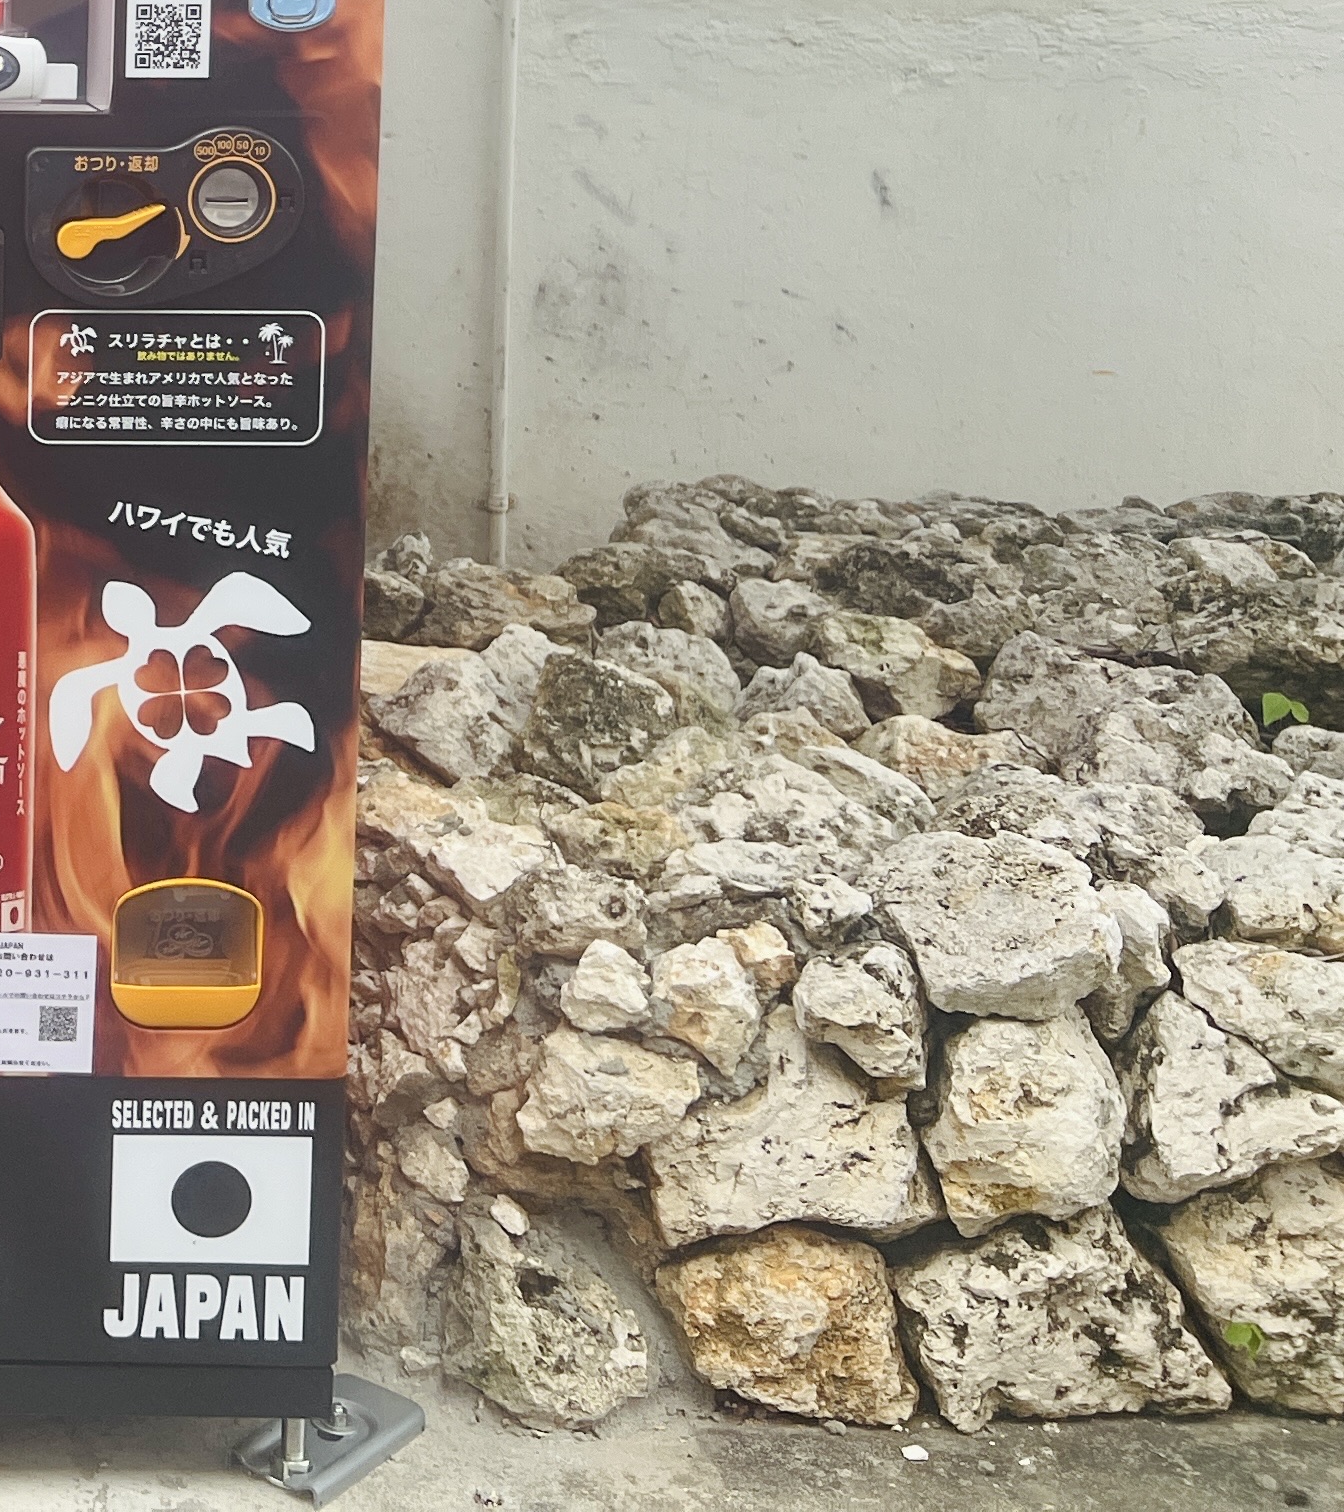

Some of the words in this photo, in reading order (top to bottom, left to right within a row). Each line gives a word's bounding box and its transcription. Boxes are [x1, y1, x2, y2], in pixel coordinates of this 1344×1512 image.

[236, 141, 248, 149] 50
[56, 372, 293, 386] アジアで生まれアメリカで人気となった
[56, 394, 272, 408] ニンニク仕立ての旨辛ホットソース。
[108, 500, 293, 559] ハワイでも人気
[112, 1100, 193, 1130] SELECTED
[201, 1101, 219, 1130] &
[227, 1101, 292, 1131] PACKED
[297, 1102, 315, 1131] IN
[103, 1274, 305, 1342] JAPAN
